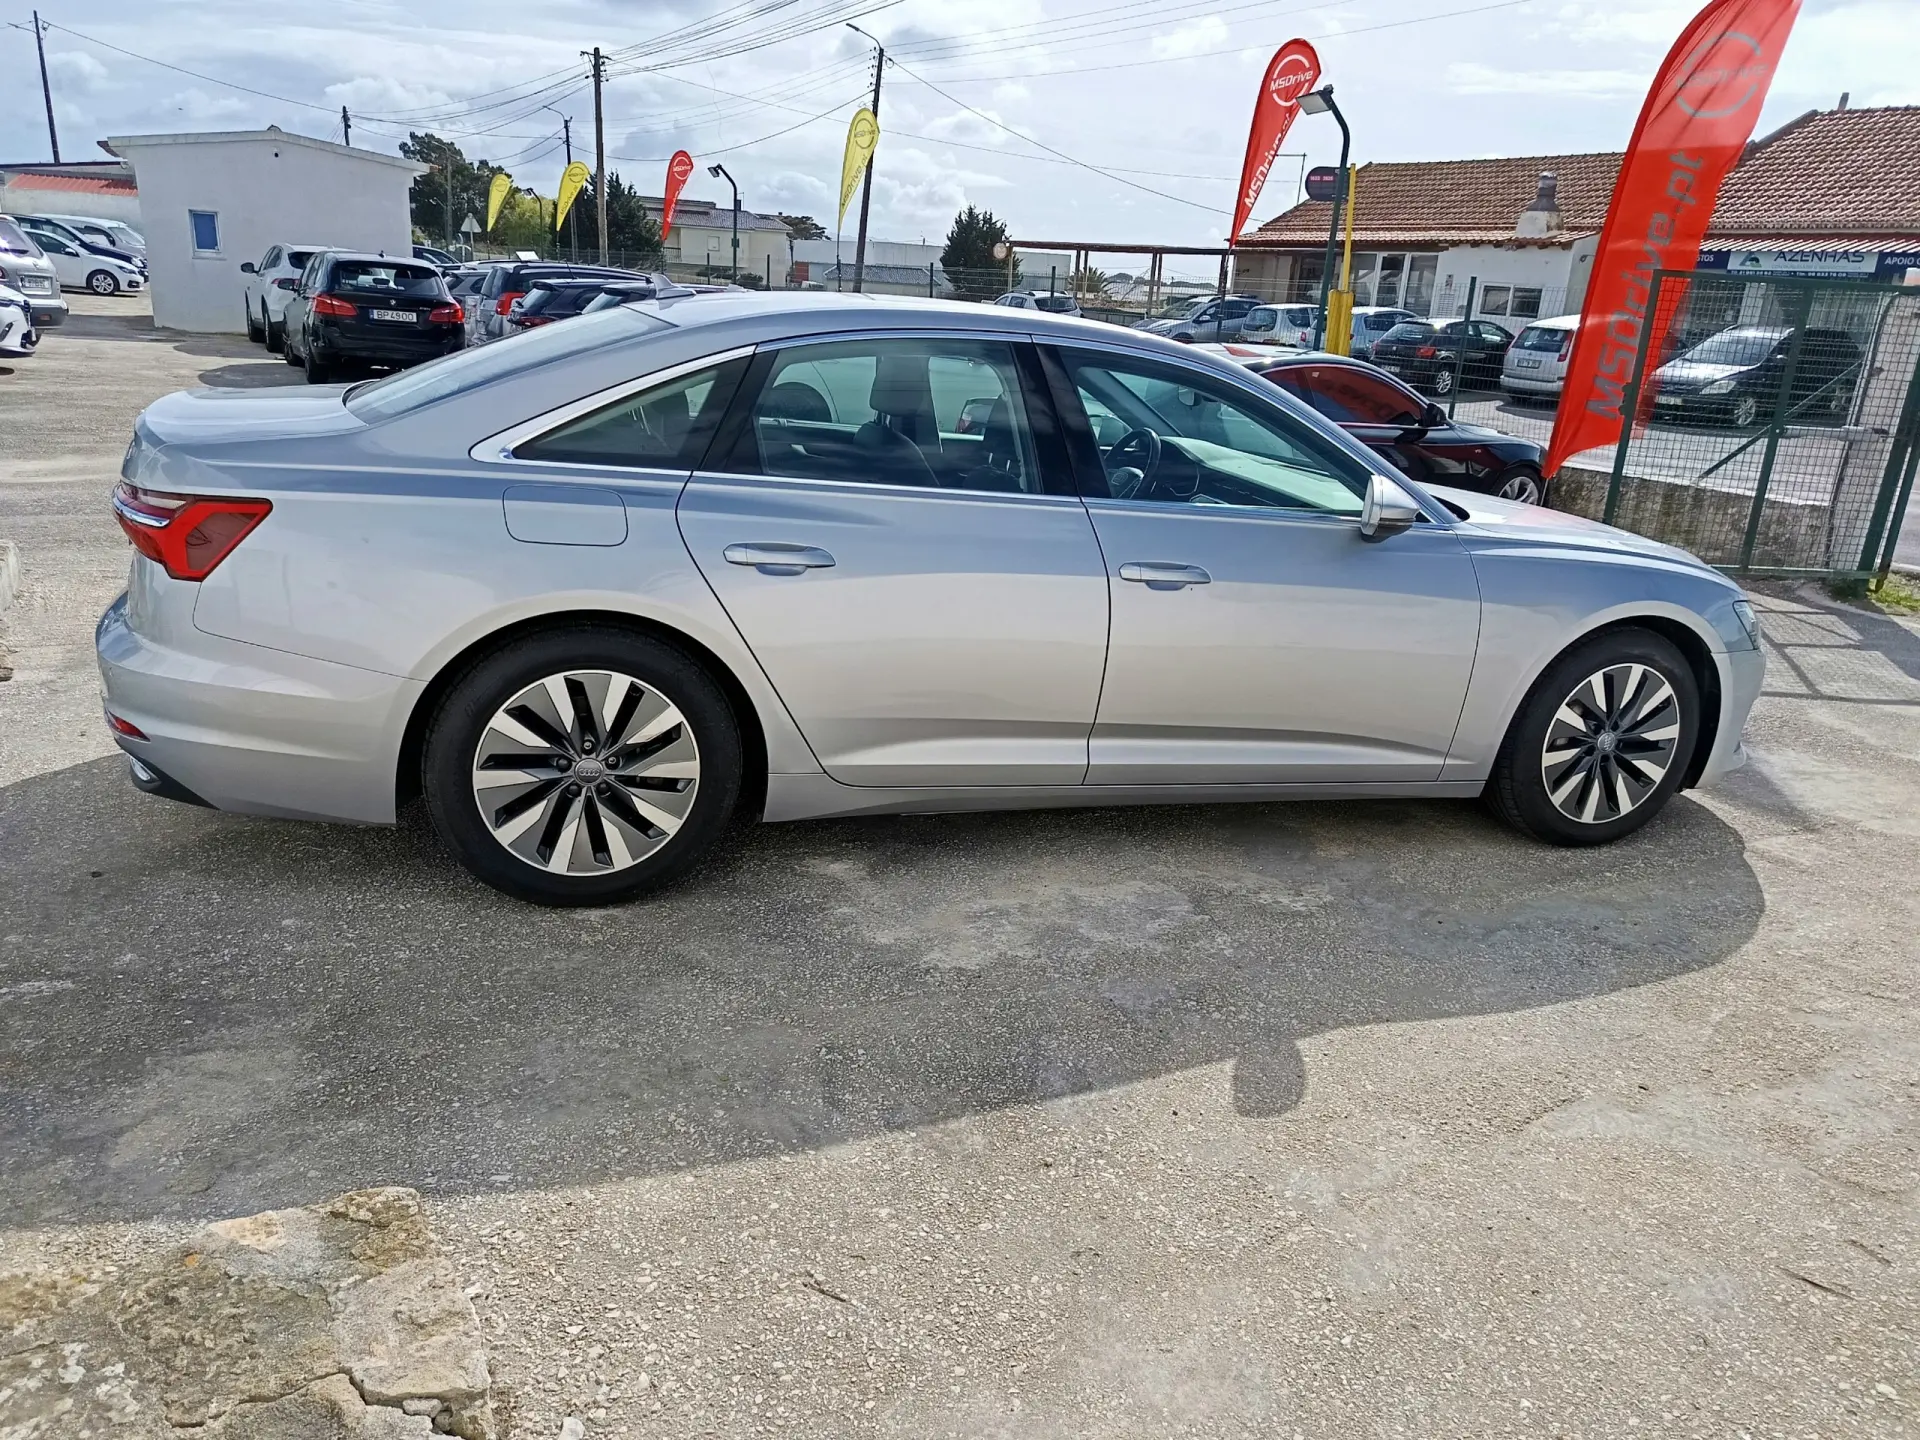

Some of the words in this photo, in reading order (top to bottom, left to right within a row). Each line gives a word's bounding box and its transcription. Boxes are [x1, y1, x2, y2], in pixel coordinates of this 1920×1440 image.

[1270, 70, 1314, 92] MSDrive
[1774, 251, 1865, 263] AZENHAS
[1884, 256, 1915, 265] APOIO
[1585, 150, 1704, 420] MSDrive.pt
[376, 310, 389, 319] BP
